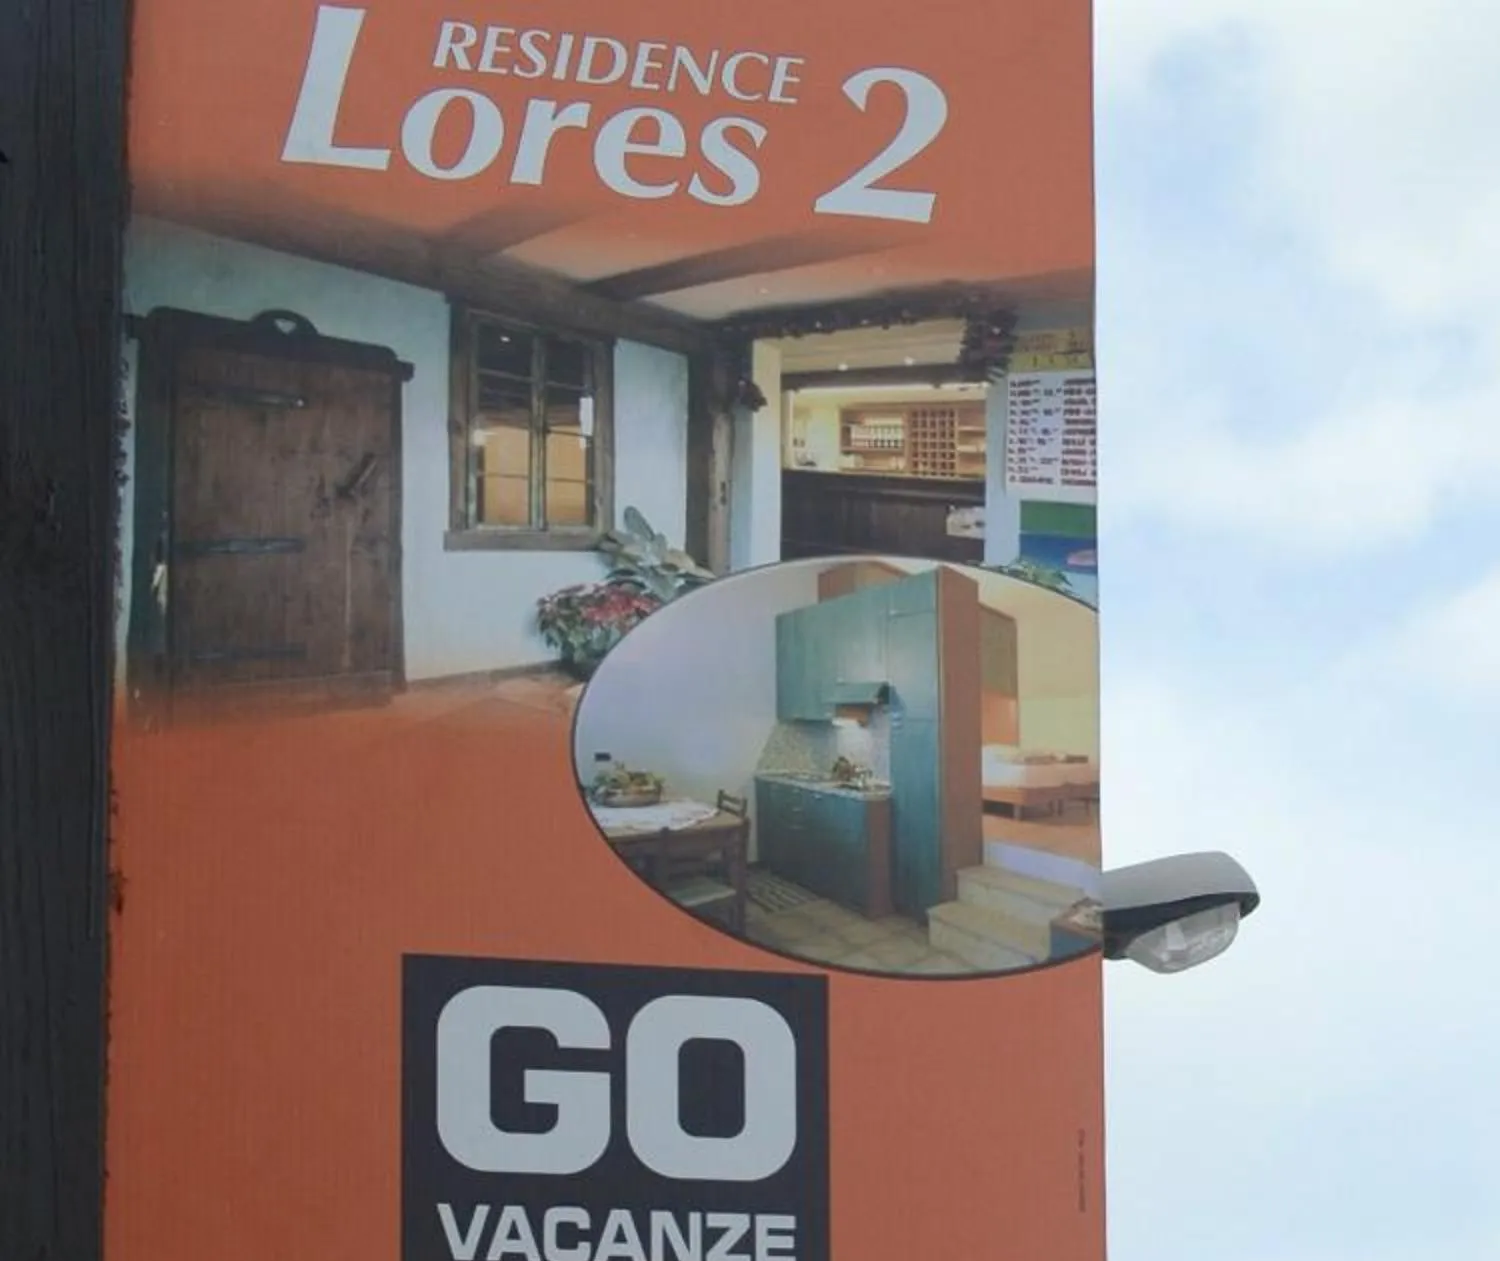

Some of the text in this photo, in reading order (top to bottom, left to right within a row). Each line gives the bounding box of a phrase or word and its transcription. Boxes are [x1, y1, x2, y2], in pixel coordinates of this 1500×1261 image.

[280, 1, 949, 224] Lores 2
[432, 20, 805, 104] RESIDENCE
[436, 985, 797, 1182] GO
